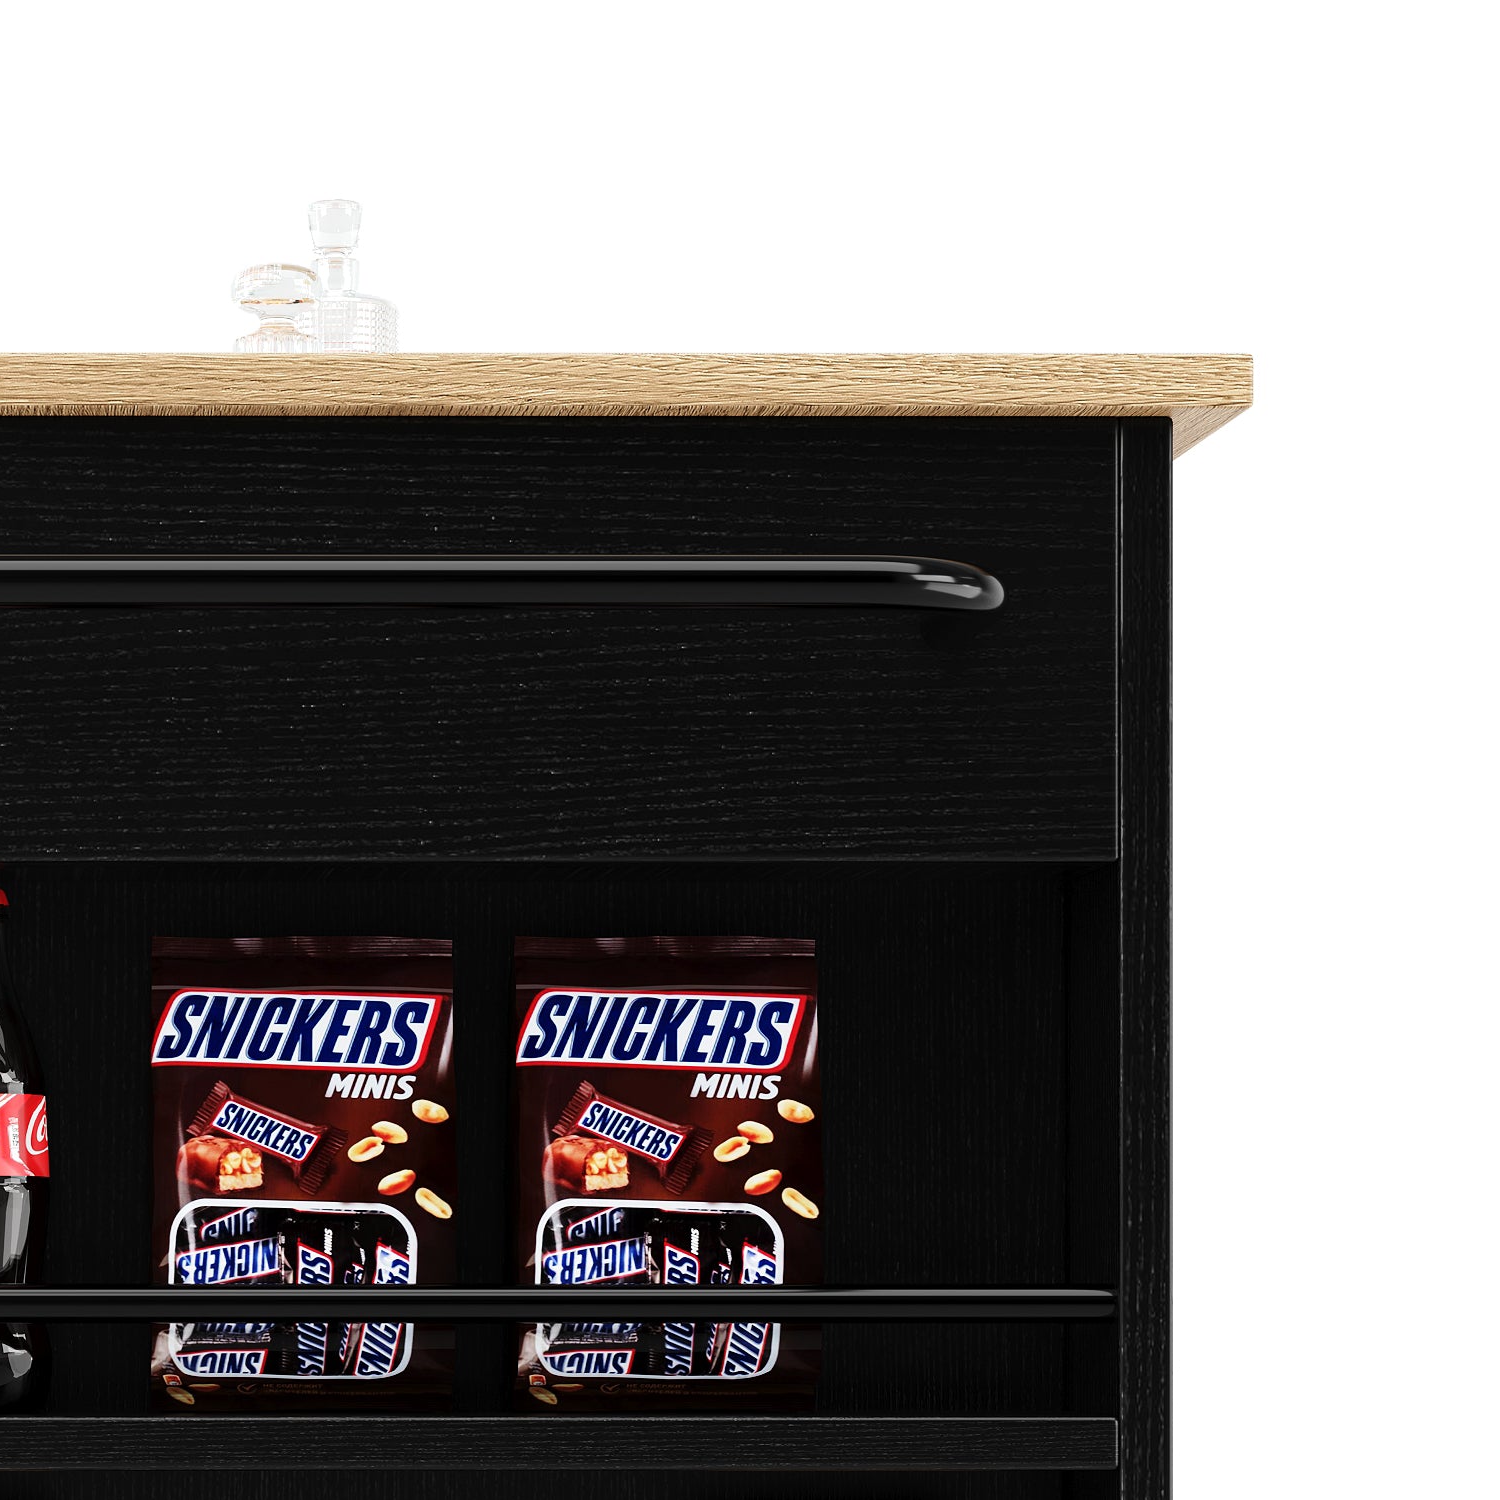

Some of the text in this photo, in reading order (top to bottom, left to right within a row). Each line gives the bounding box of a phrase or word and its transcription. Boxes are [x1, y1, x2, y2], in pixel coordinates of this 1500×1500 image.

[156, 994, 430, 1066] SNICKERS
[520, 994, 794, 1066] SNICKERS
[325, 1073, 416, 1100] MINIS
[690, 1073, 781, 1100] MINIS
[216, 1102, 314, 1160] SNICKERS
[581, 1102, 680, 1160] SNICKERS
